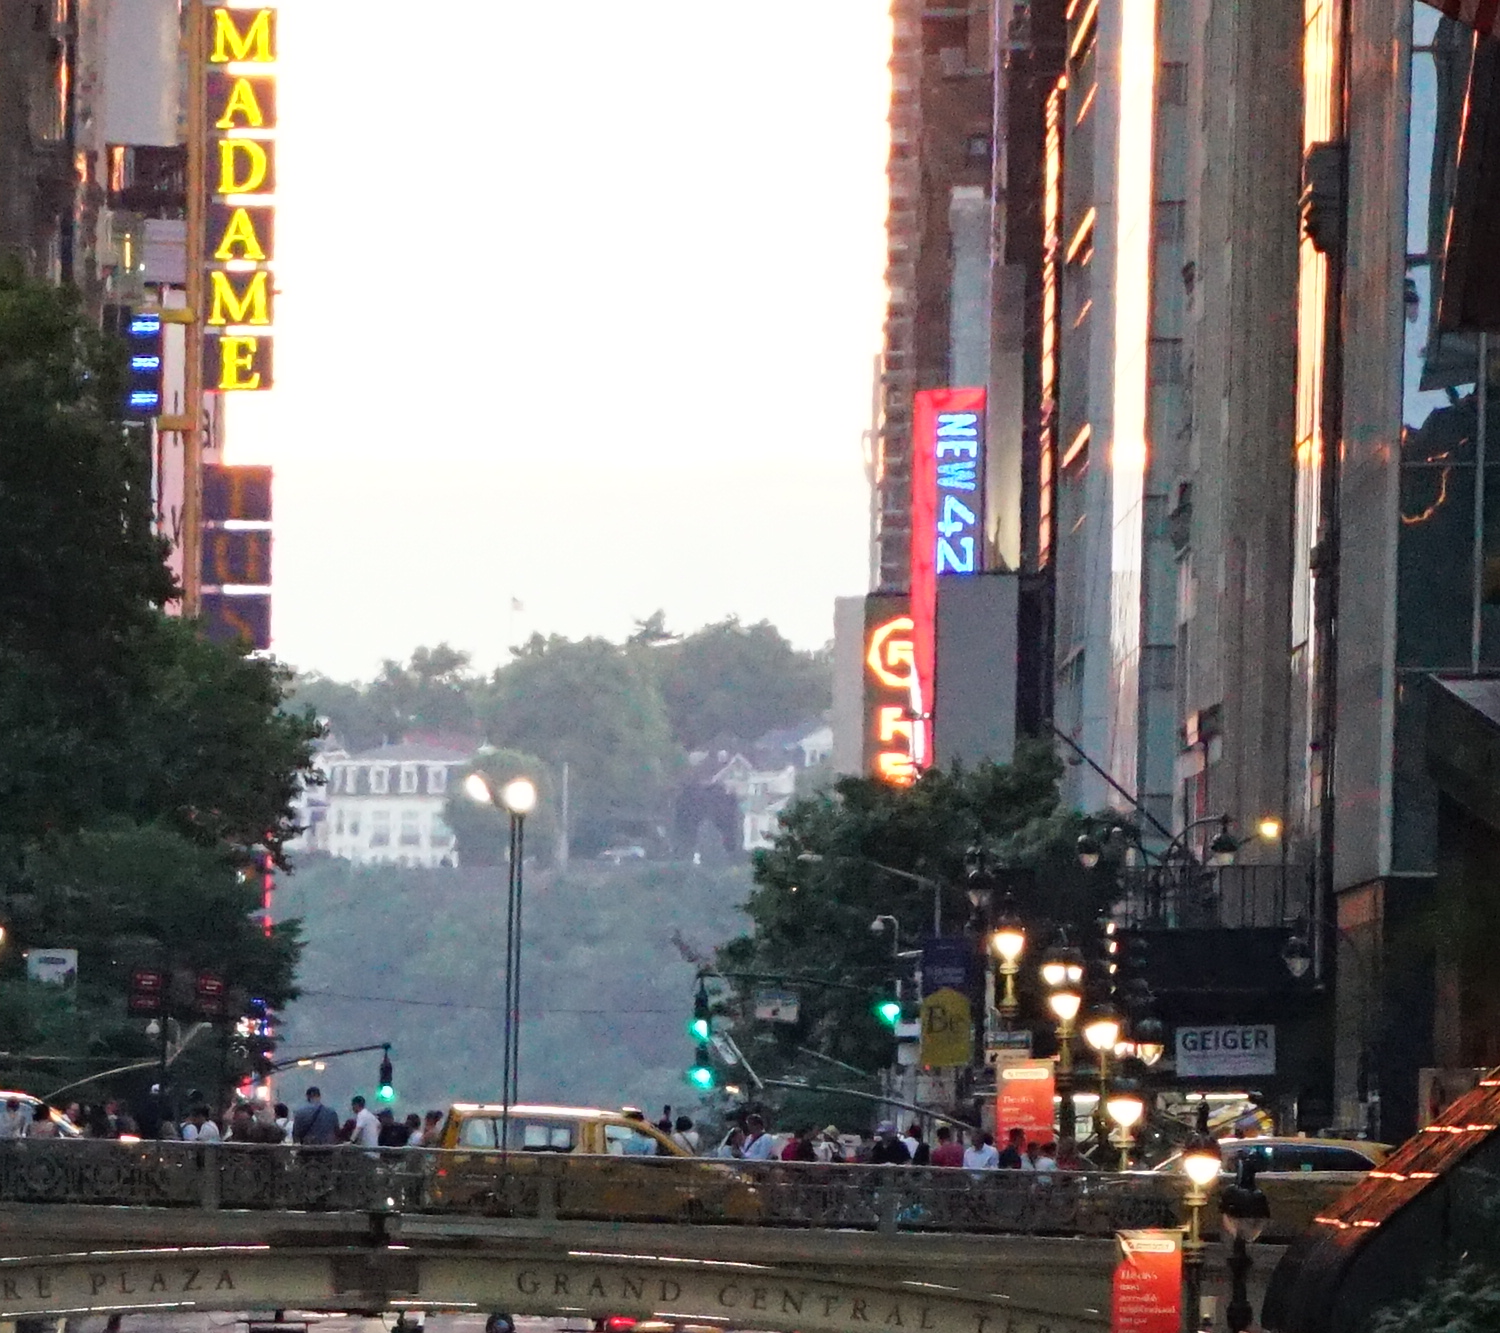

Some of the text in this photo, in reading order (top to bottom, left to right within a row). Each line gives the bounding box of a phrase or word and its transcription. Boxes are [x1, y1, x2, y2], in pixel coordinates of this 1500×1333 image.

[209, 7, 274, 391] MADAME
[936, 412, 978, 575] NEW 42
[1181, 1029, 1269, 1051] GEIGER
[88, 1267, 237, 1296] PLAZA
[516, 1268, 682, 1303] GRAND
[719, 1284, 936, 1330] CENTRAL
